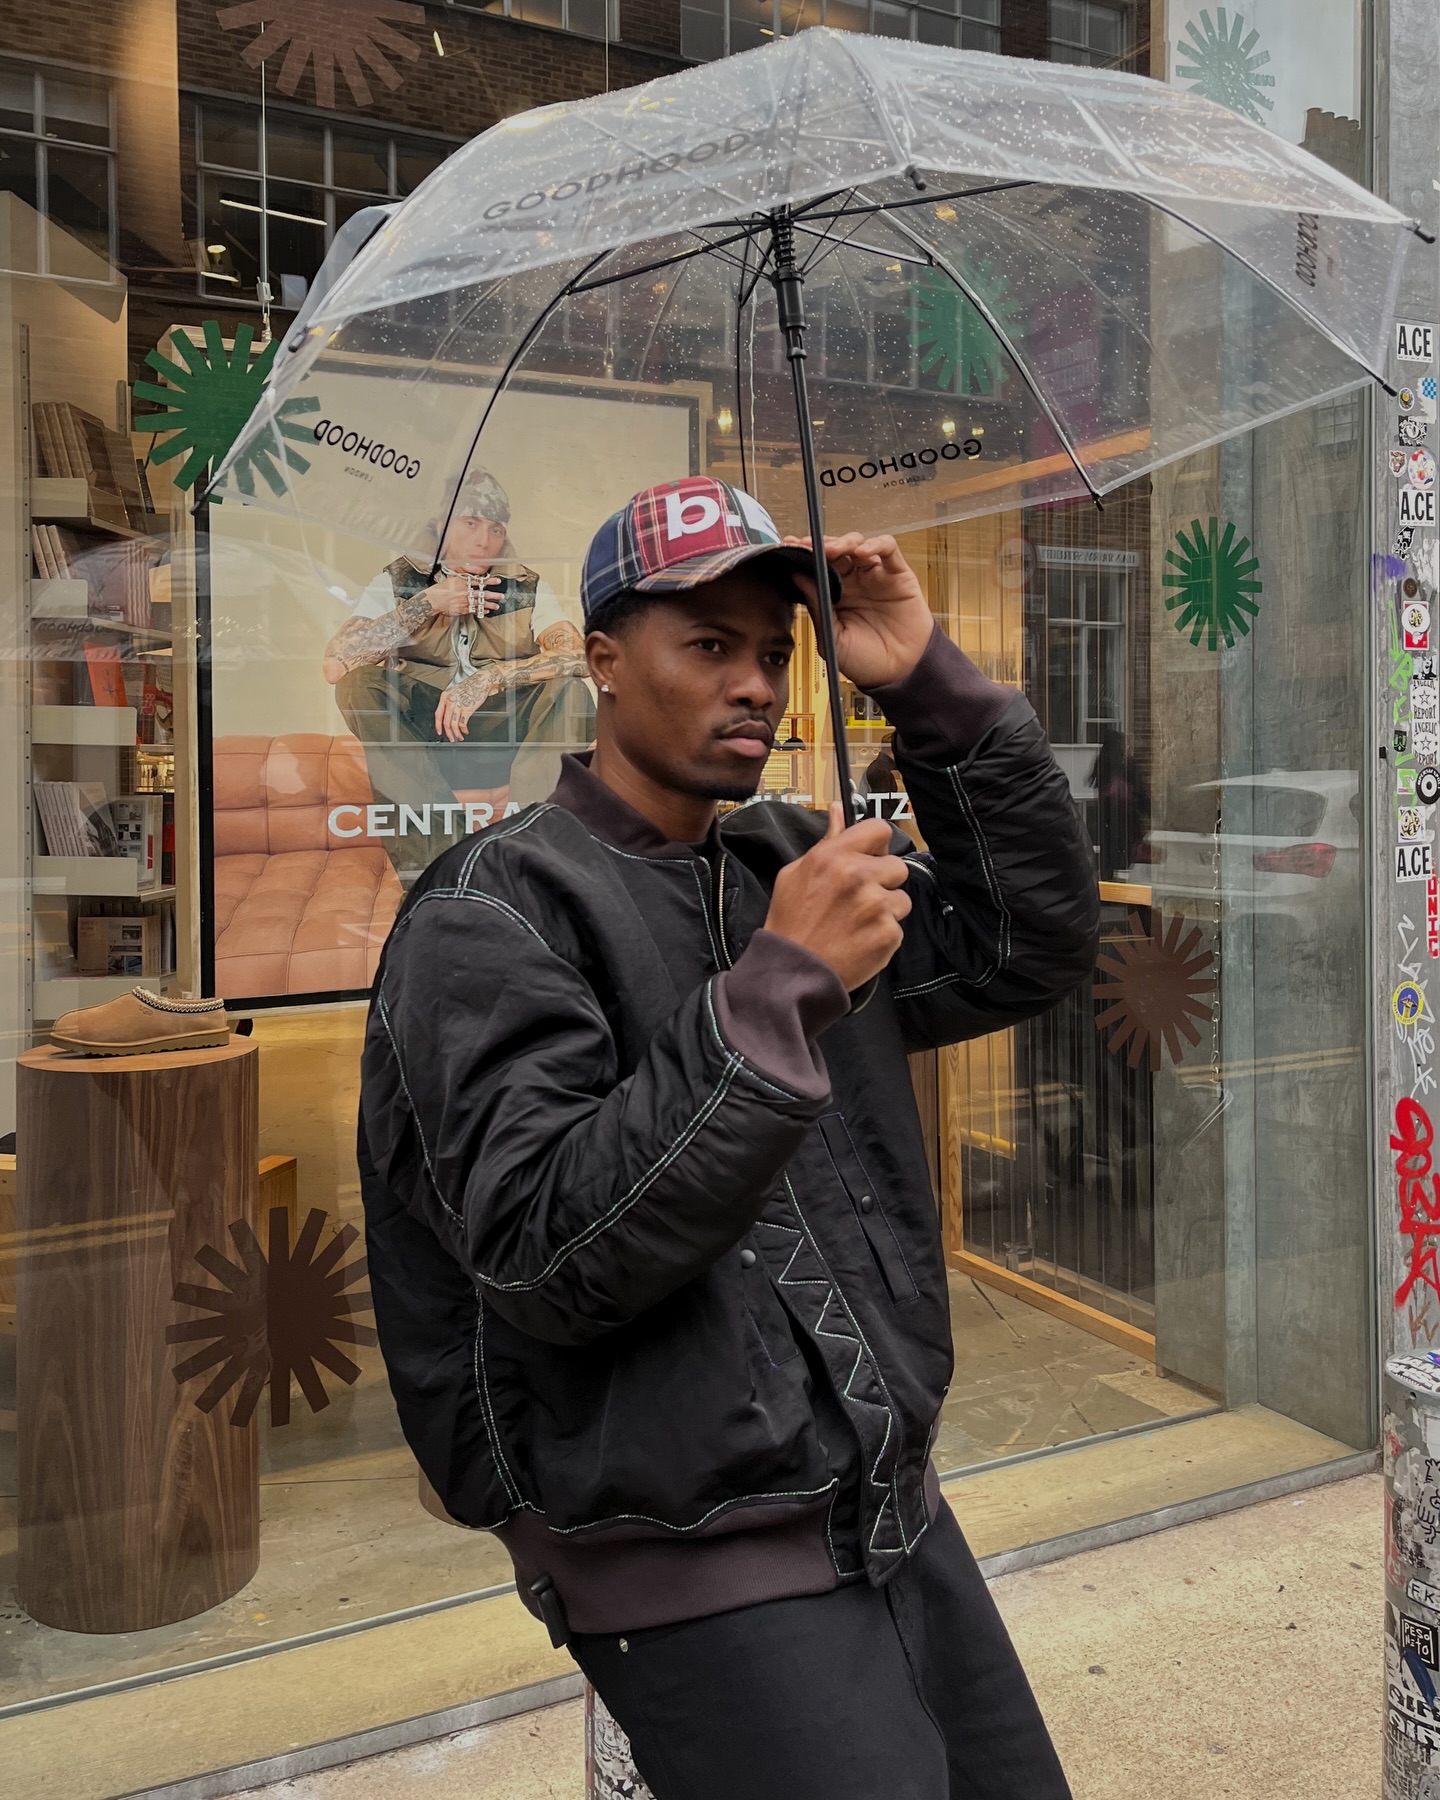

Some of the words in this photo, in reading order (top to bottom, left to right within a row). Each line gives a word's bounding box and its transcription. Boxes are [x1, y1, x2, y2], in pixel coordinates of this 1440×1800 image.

[483, 133, 750, 220] GOODHOOD
[1398, 325, 1431, 357] A.CE
[1400, 491, 1434, 521] A.CE
[1413, 704, 1436, 719] REPORT
[1414, 722, 1437, 736] ANGELIC
[1397, 846, 1431, 877] A.CE
